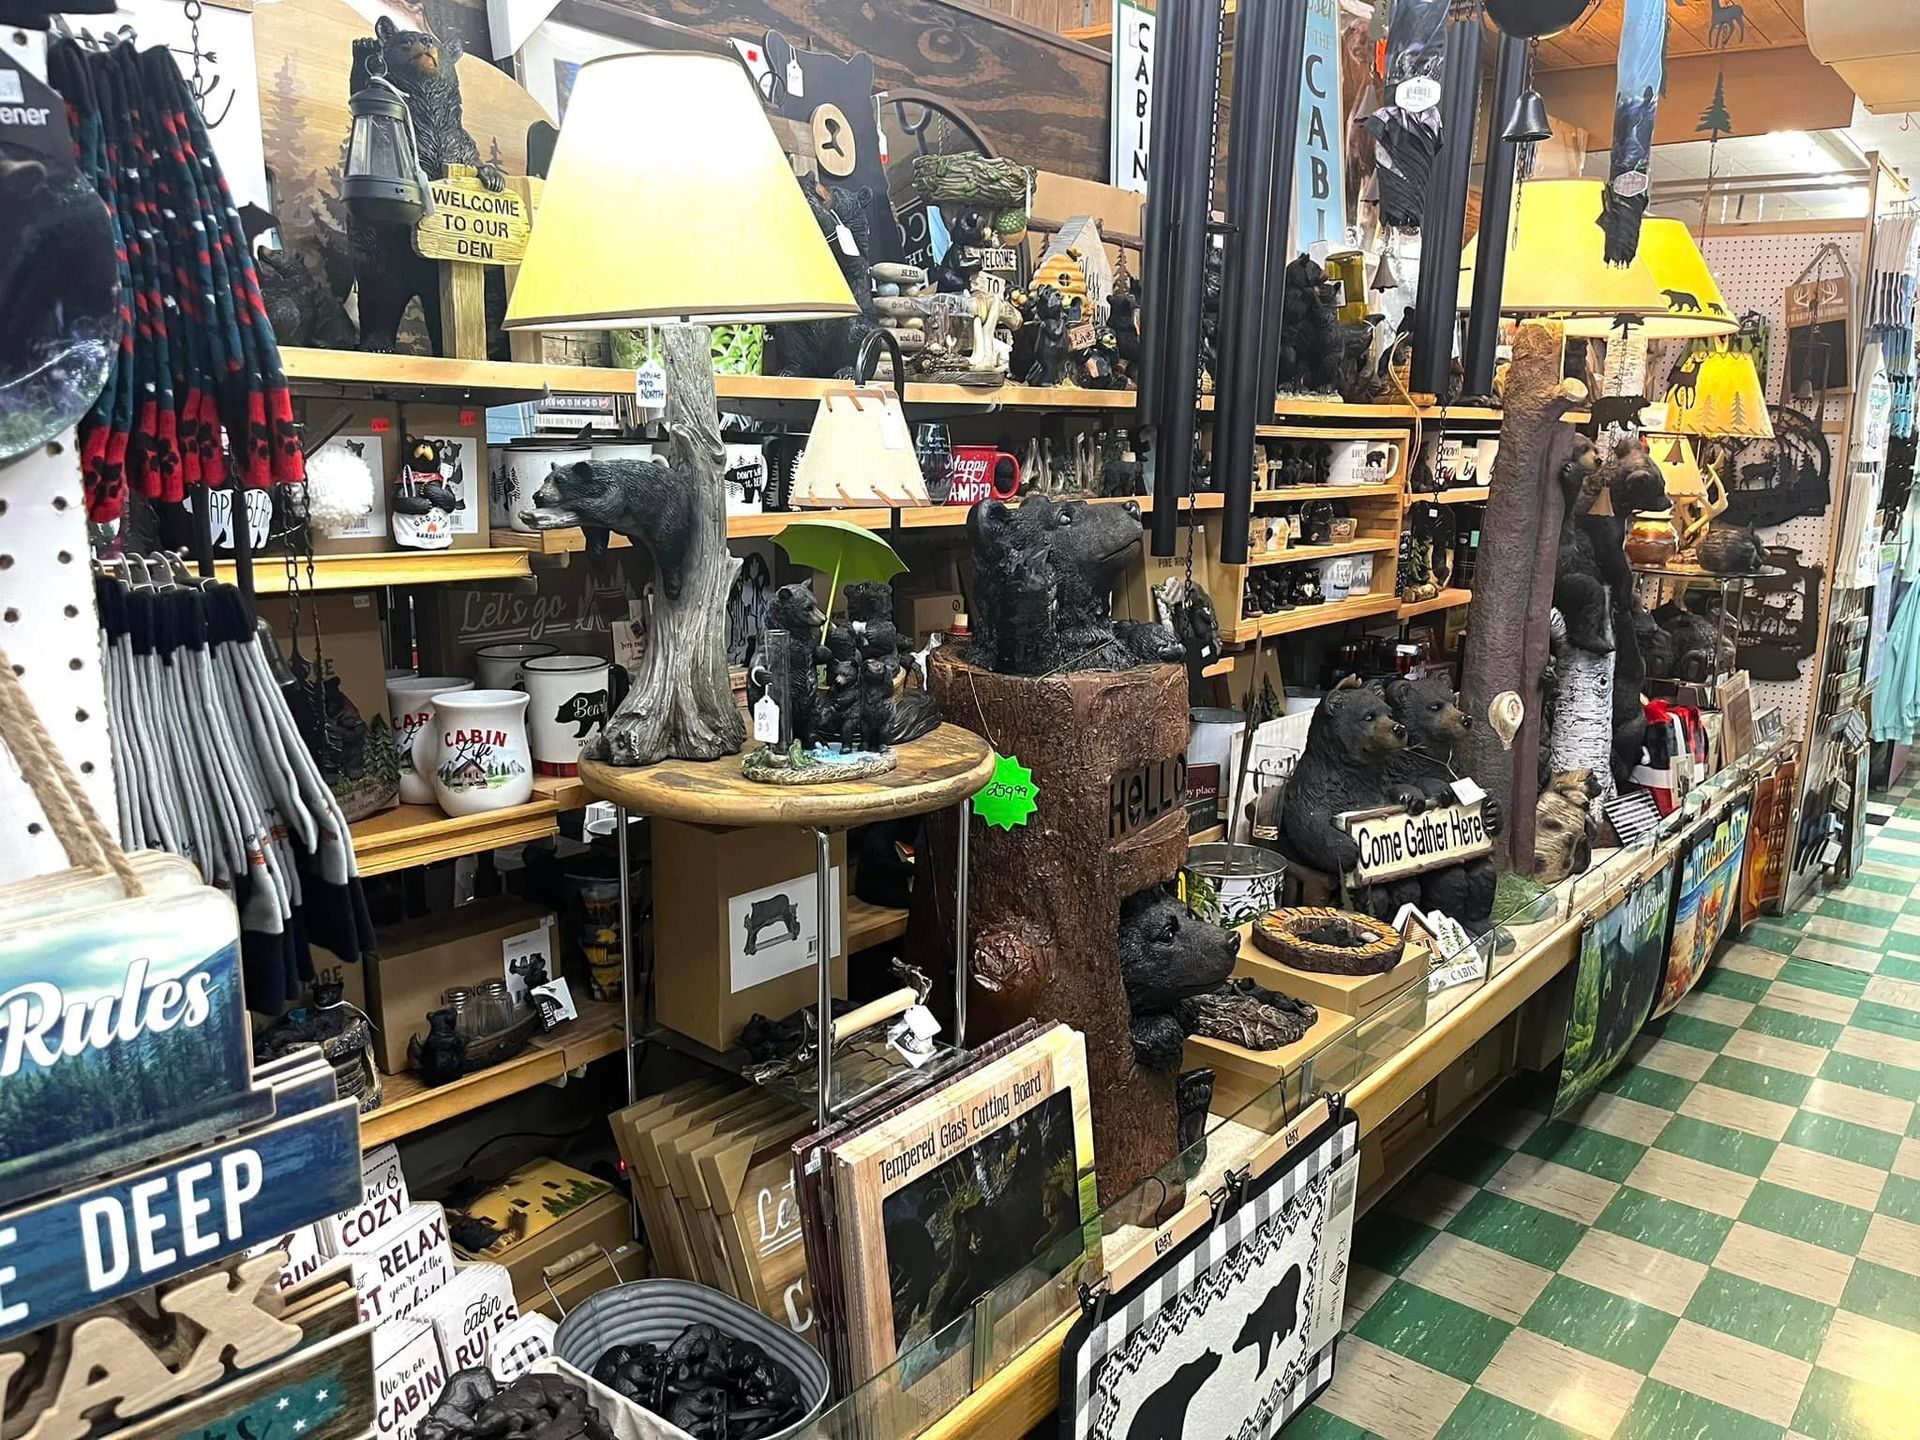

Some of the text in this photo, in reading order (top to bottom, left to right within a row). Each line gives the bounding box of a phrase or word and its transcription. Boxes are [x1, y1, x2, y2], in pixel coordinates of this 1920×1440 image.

[1132, 22, 1151, 182] CABIN
[1304, 54, 1331, 241] CABI
[432, 188, 520, 217] WELCOME
[442, 213, 509, 238] TO OUR
[457, 240, 493, 259] DEN
[987, 277, 1000, 294] TO
[944, 454, 988, 482] Happy
[210, 492, 233, 526] AP
[949, 482, 991, 501] AMPER
[461, 590, 567, 640] Let's go
[444, 728, 508, 748] CABIN
[455, 738, 493, 764] Life
[1196, 785, 1216, 800] place
[1358, 809, 1483, 869] Come Gather Here
[1628, 887, 1667, 935] Welcome
[1450, 963, 1479, 981] CABIN
[0, 957, 222, 1077] Rules
[878, 1132, 936, 1185] Tempered
[939, 1117, 968, 1148] Glass
[971, 1092, 1010, 1130] Cutting
[1012, 1071, 1042, 1106] Board
[387, 1164, 399, 1190] &
[79, 1148, 264, 1293] DEEP
[342, 1188, 402, 1248] COZY
[379, 1216, 446, 1283] RELAX
[279, 1254, 318, 1291] BIN
[389, 1255, 443, 1303] you're at the
[463, 1293, 502, 1336] cabin
[378, 1364, 442, 1433] CABIN
[380, 1370, 411, 1400] We're
